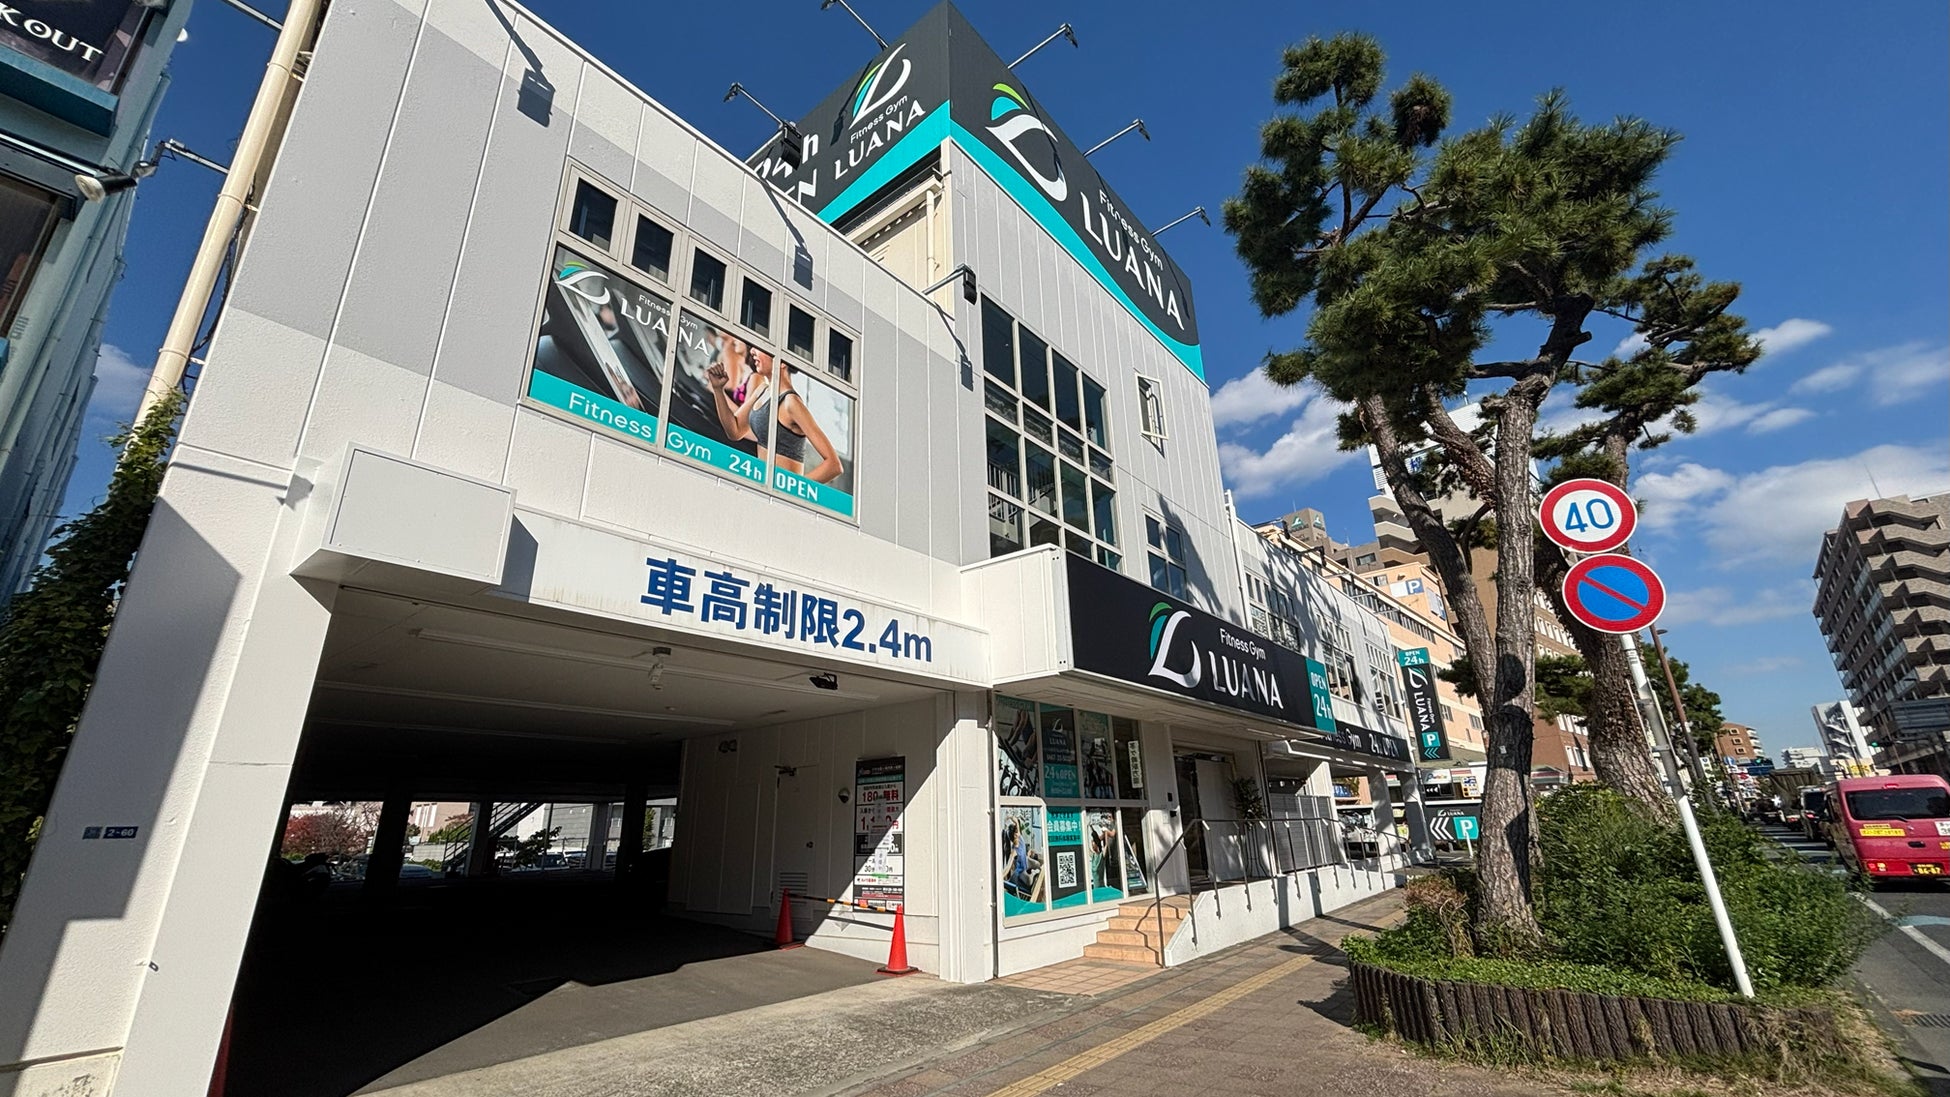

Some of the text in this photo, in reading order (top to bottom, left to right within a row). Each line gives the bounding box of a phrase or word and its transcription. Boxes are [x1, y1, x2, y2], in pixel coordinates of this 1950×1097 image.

[849, 95, 909, 144] Fitness Gym
[834, 100, 926, 180] LUANA
[1099, 191, 1165, 271] Fitness Gym
[1081, 191, 1185, 331] LUANA
[638, 293, 672, 316] Fitness
[620, 299, 710, 357] LUANA
[568, 391, 819, 502] Fitness Gym 24h OPEN
[1565, 498, 1614, 533] 40
[1409, 580, 1421, 594] P
[640, 556, 933, 663] 車高制限2.4m
[1220, 628, 1267, 660] Fitness Gym
[1404, 656, 1425, 666] 24h
[1208, 650, 1284, 710] LUANA
[1310, 671, 1327, 690] OPEN
[1314, 693, 1333, 719] 24h
[1413, 692, 1431, 732] LUANA
[1427, 734, 1436, 746] P
[107, 828, 135, 837] 2-60
[1460, 820, 1474, 837] P
